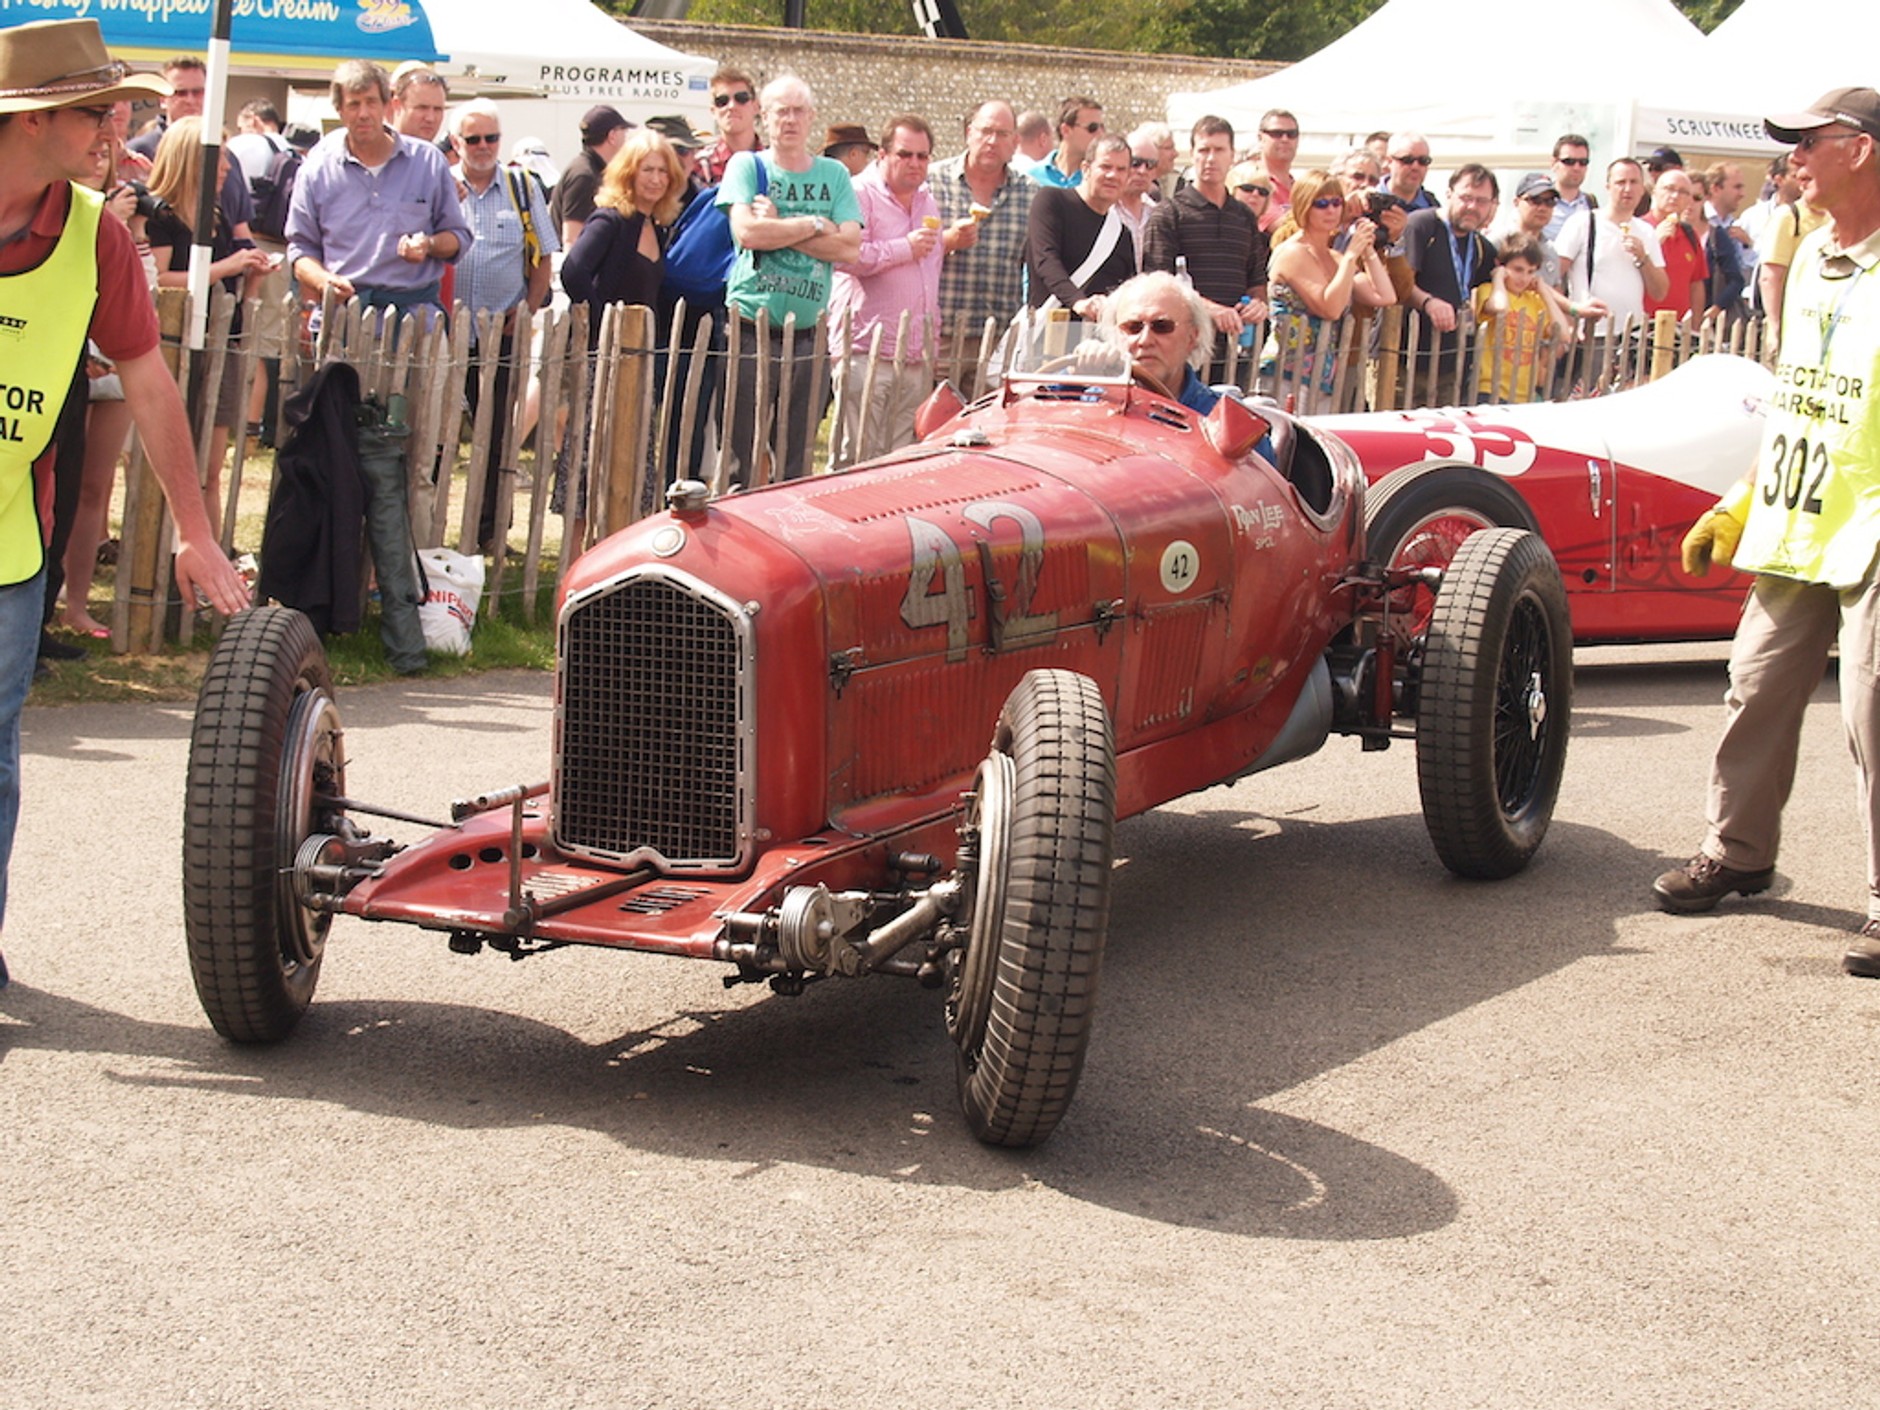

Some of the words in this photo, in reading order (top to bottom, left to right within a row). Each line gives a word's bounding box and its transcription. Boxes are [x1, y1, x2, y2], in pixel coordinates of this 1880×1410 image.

[540, 65, 684, 86] PROGRAMMES
[589, 86, 624, 97] FREE
[632, 87, 679, 99] RADIO
[1763, 433, 1828, 515] 302
[1171, 554, 1188, 580] 42
[900, 500, 1059, 663] 42
